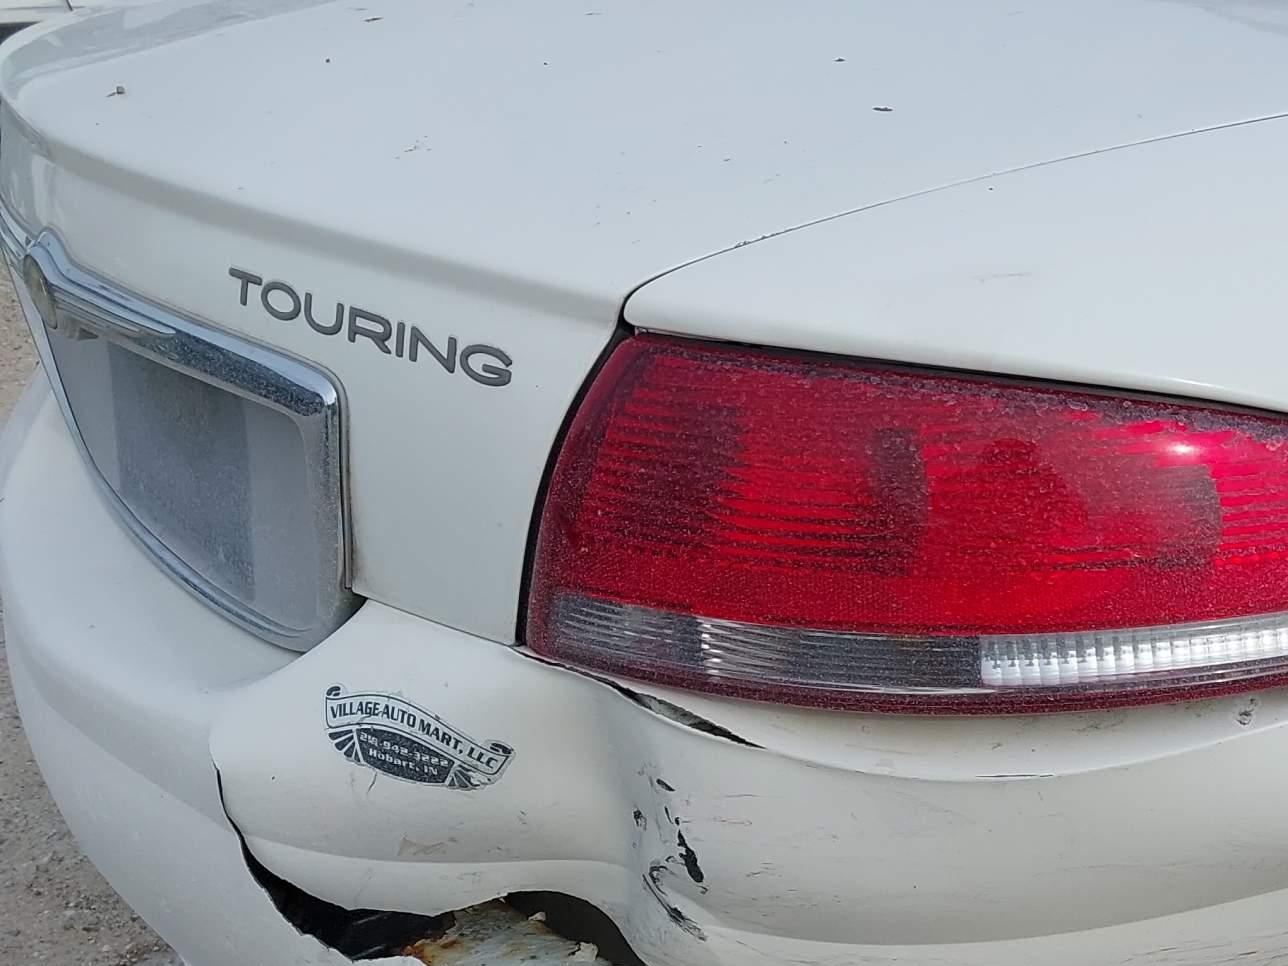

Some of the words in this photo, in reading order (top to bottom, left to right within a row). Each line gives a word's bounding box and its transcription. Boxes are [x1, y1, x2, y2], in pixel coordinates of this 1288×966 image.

[228, 266, 512, 387] TOURING
[330, 701, 381, 719] VILLAGE
[381, 705, 417, 728] AUTO
[418, 718, 464, 755] MART,
[467, 746, 499, 769] LLC
[423, 765, 438, 776] IN
